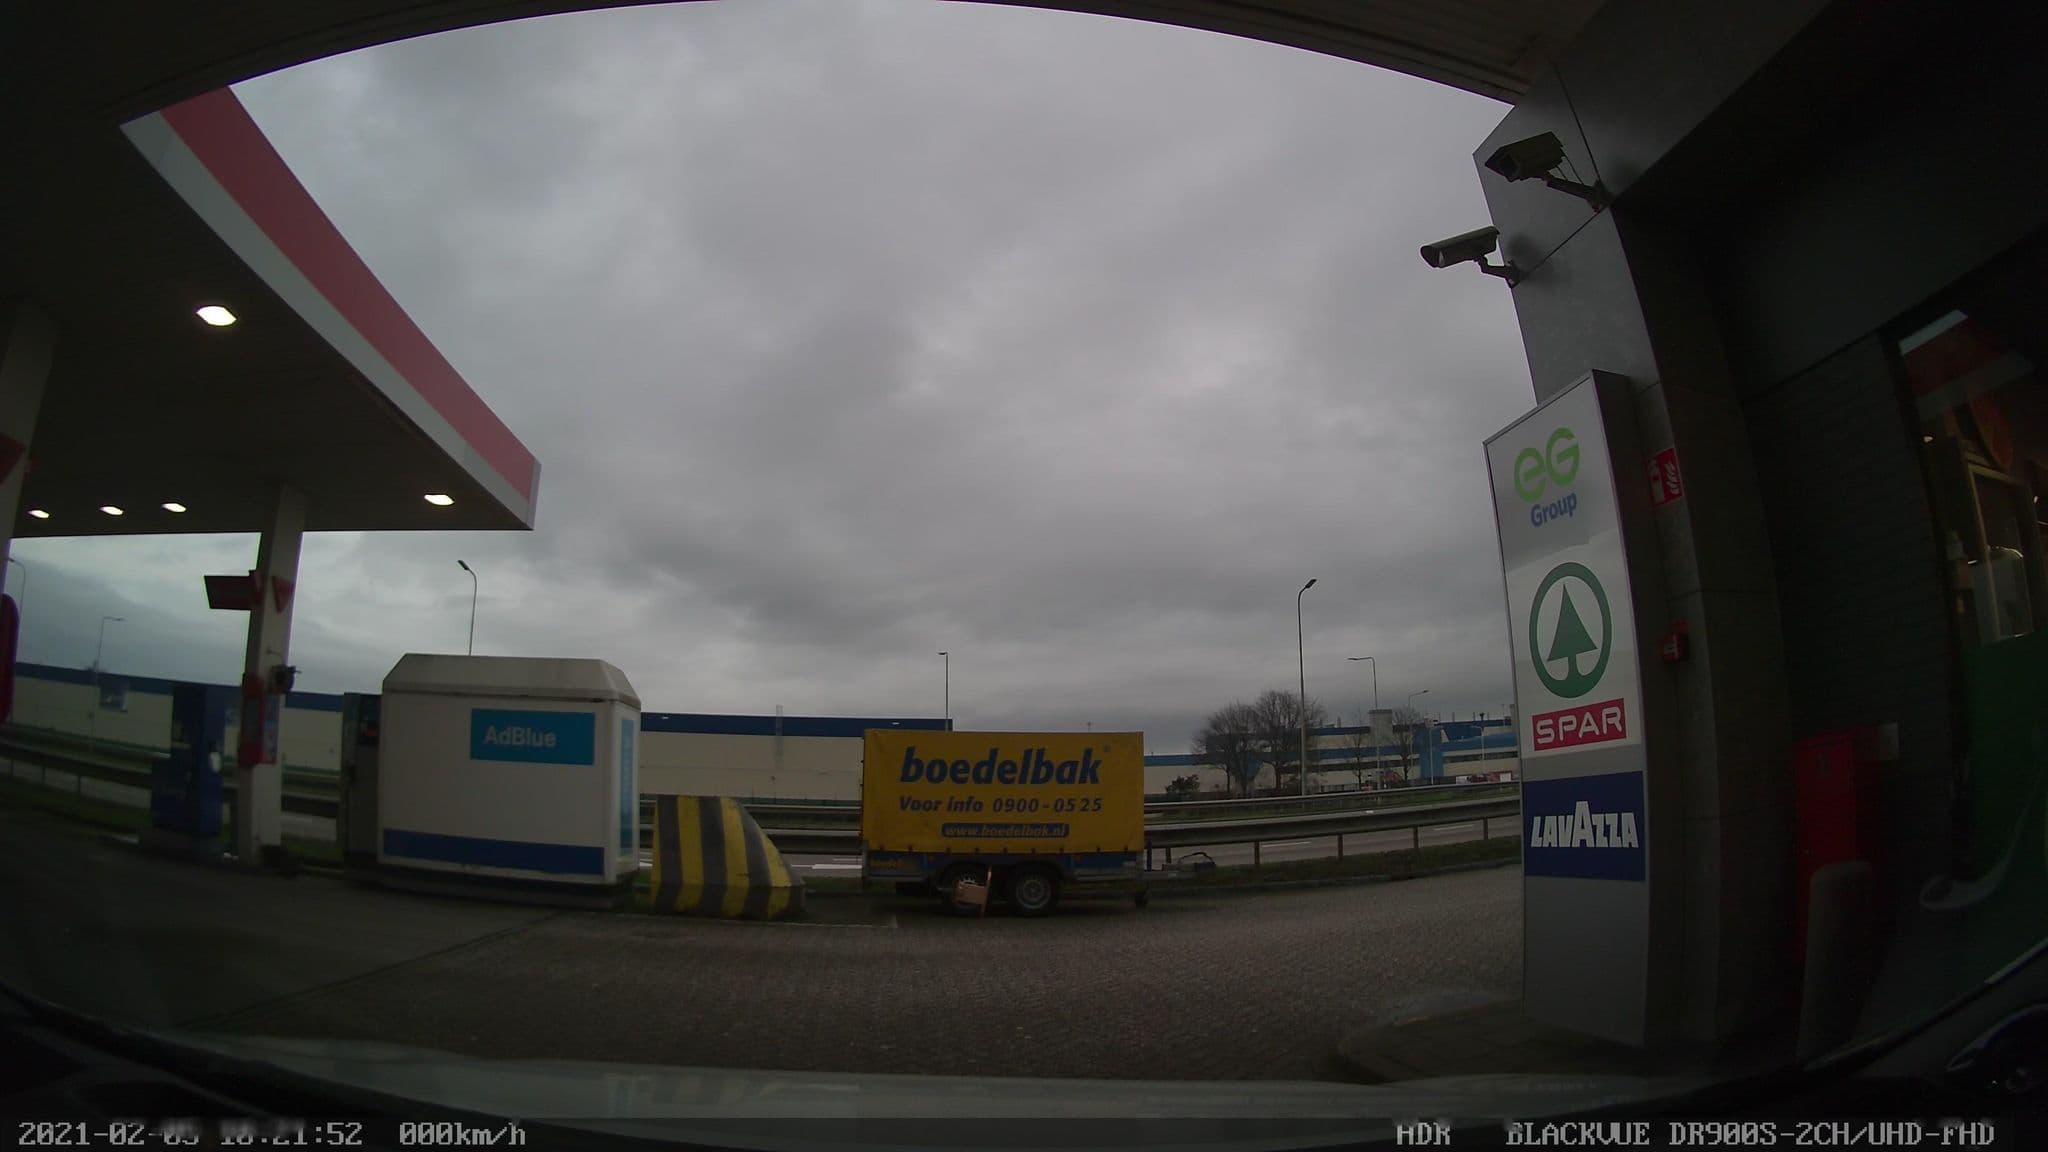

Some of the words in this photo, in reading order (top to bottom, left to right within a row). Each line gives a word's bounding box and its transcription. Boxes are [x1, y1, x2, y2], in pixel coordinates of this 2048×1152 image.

[1530, 492, 1577, 527] Group
[483, 725, 557, 747] AdBlue
[1536, 706, 1622, 744] SPAR
[900, 746, 1102, 785] boedelbak
[899, 796, 942, 812] Voor
[946, 797, 984, 812] info
[945, 824, 1067, 838] www.boedelbak.nl
[1531, 801, 1639, 848] LAVAZZA
